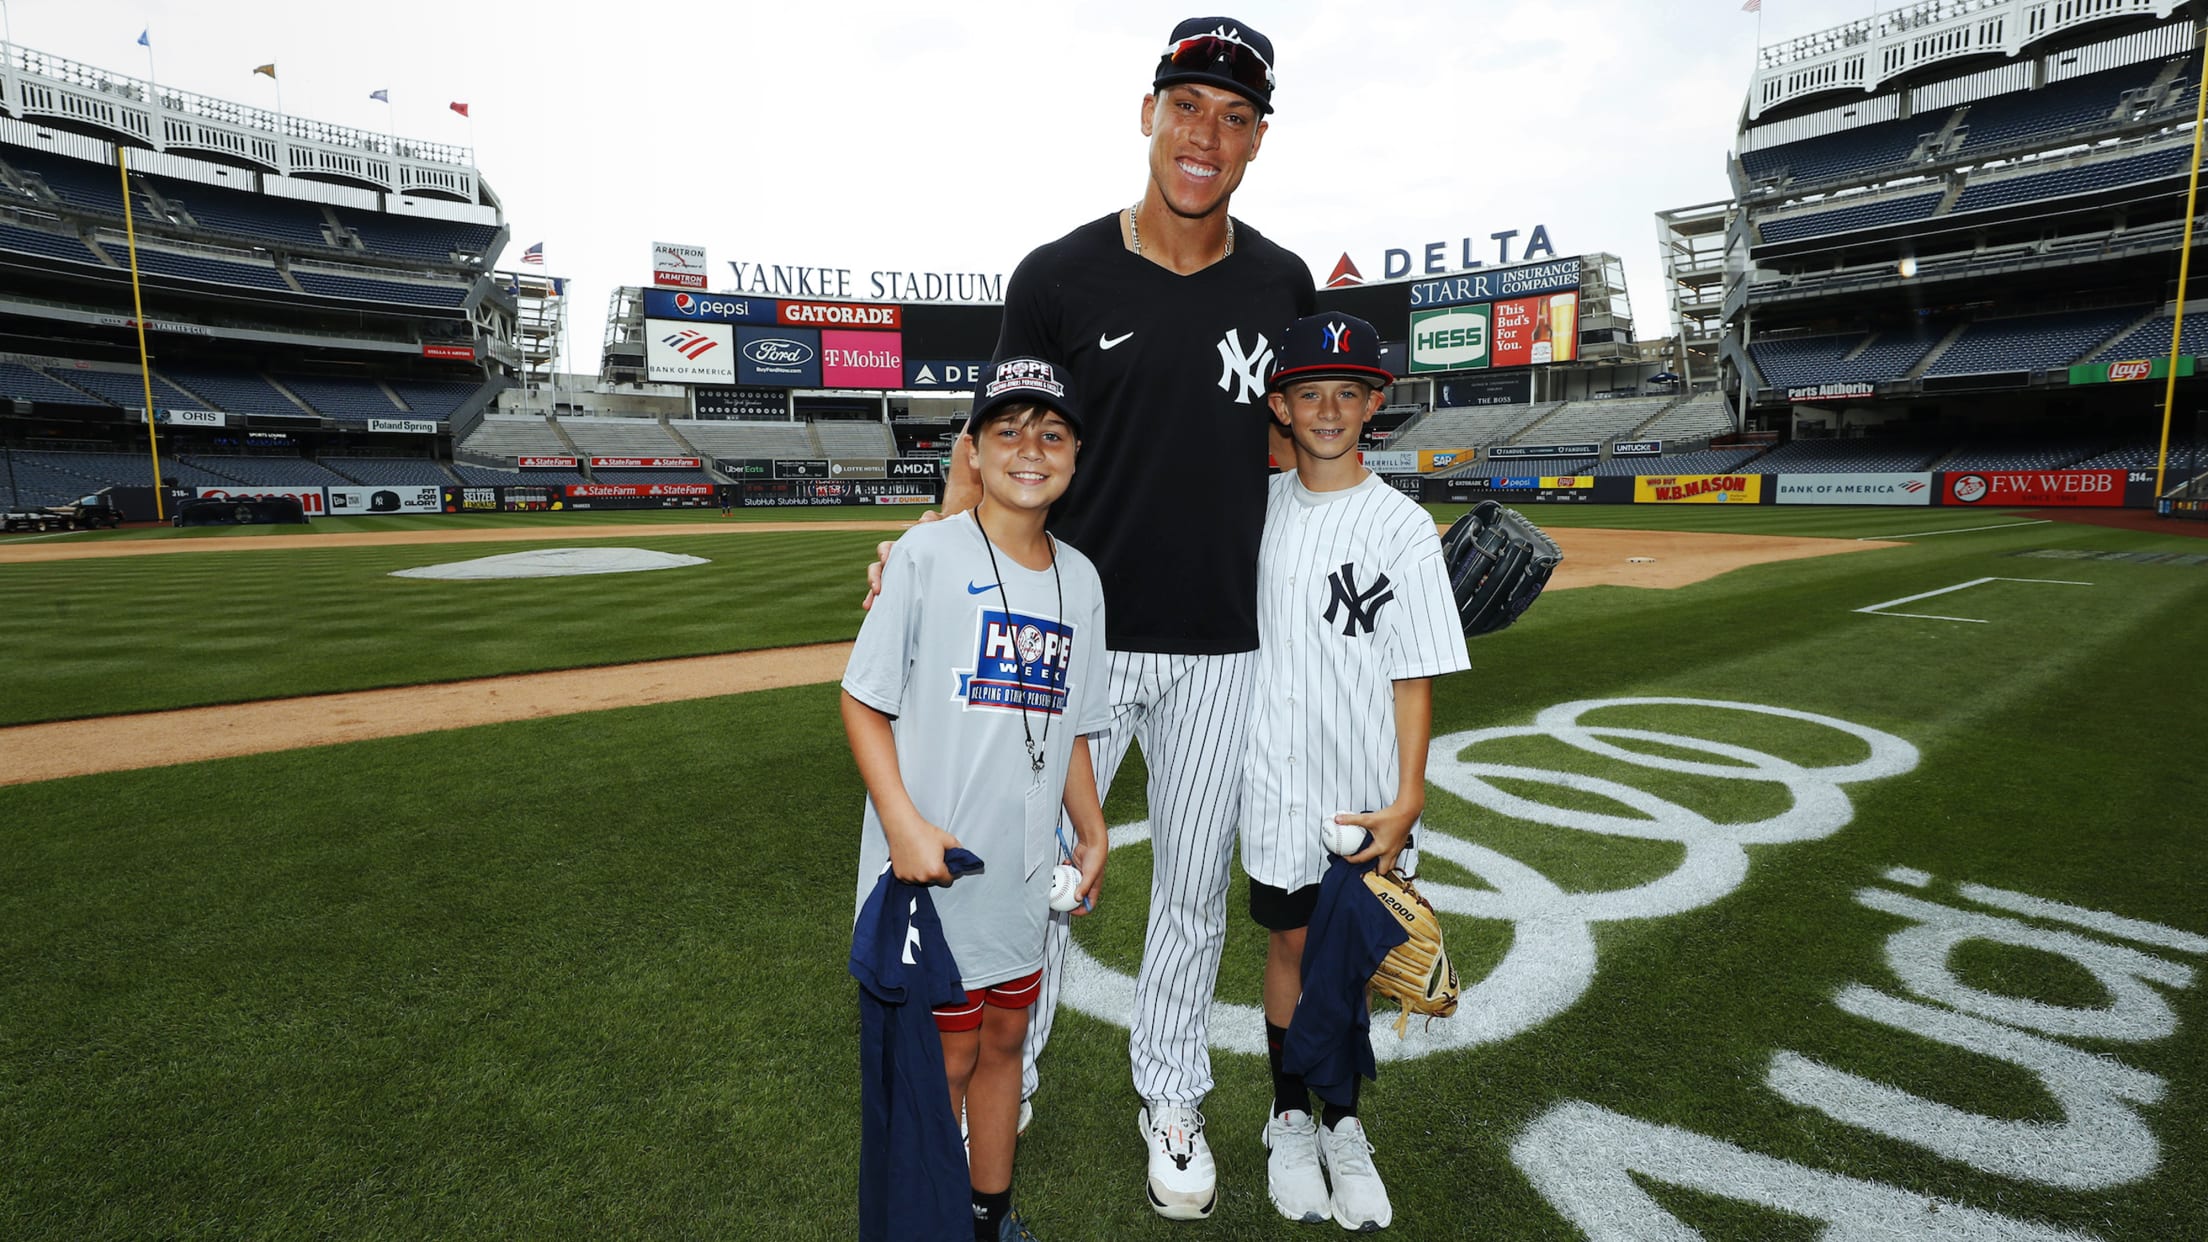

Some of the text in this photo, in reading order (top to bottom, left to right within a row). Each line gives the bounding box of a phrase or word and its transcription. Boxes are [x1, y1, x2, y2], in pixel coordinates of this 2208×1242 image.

[655, 246, 704, 257] ARMITRON
[1385, 224, 1556, 279] DELTA
[658, 273, 703, 282] ARMITRON
[1503, 261, 1580, 283] INSURANCE
[728, 261, 1002, 301] YANKEE STADIUM
[1502, 272, 1580, 294] COMPANIES
[1410, 276, 1492, 305] STARR
[700, 300, 749, 318] pepsi
[785, 305, 893, 325] GATORADE
[1497, 304, 1525, 316] This
[1497, 315, 1530, 327] Bud's
[1321, 321, 1352, 353] NY
[1418, 327, 1482, 351] HESS
[1497, 329, 1517, 340] For
[756, 342, 802, 362] Ford
[1497, 340, 1523, 351] You.
[842, 350, 901, 369] Mobile
[1216, 328, 1275, 404] NY
[650, 365, 732, 376] BANK OF AMERICA
[999, 362, 1050, 377] HOPE
[1788, 382, 1874, 398] Parts Authority
[182, 411, 217, 422] ORIS
[372, 420, 433, 433] Poland Spring
[1433, 455, 1453, 466] SAP
[725, 465, 764, 473] Uber Eats
[893, 464, 923, 474] AMD
[1510, 479, 1530, 487] pepsi
[1647, 478, 1676, 486] WHO BUT
[1781, 485, 1895, 493] BANK OF AMERICA
[1991, 474, 2113, 493] F.W. WEBB
[463, 492, 496, 501] SELTZER
[744, 498, 775, 506] StubHub
[811, 497, 841, 505] StubHub
[1323, 562, 1394, 637] NY
[985, 621, 1071, 669] HOPE
[971, 686, 1002, 701] HELPING
[1377, 891, 1415, 922] A2000
